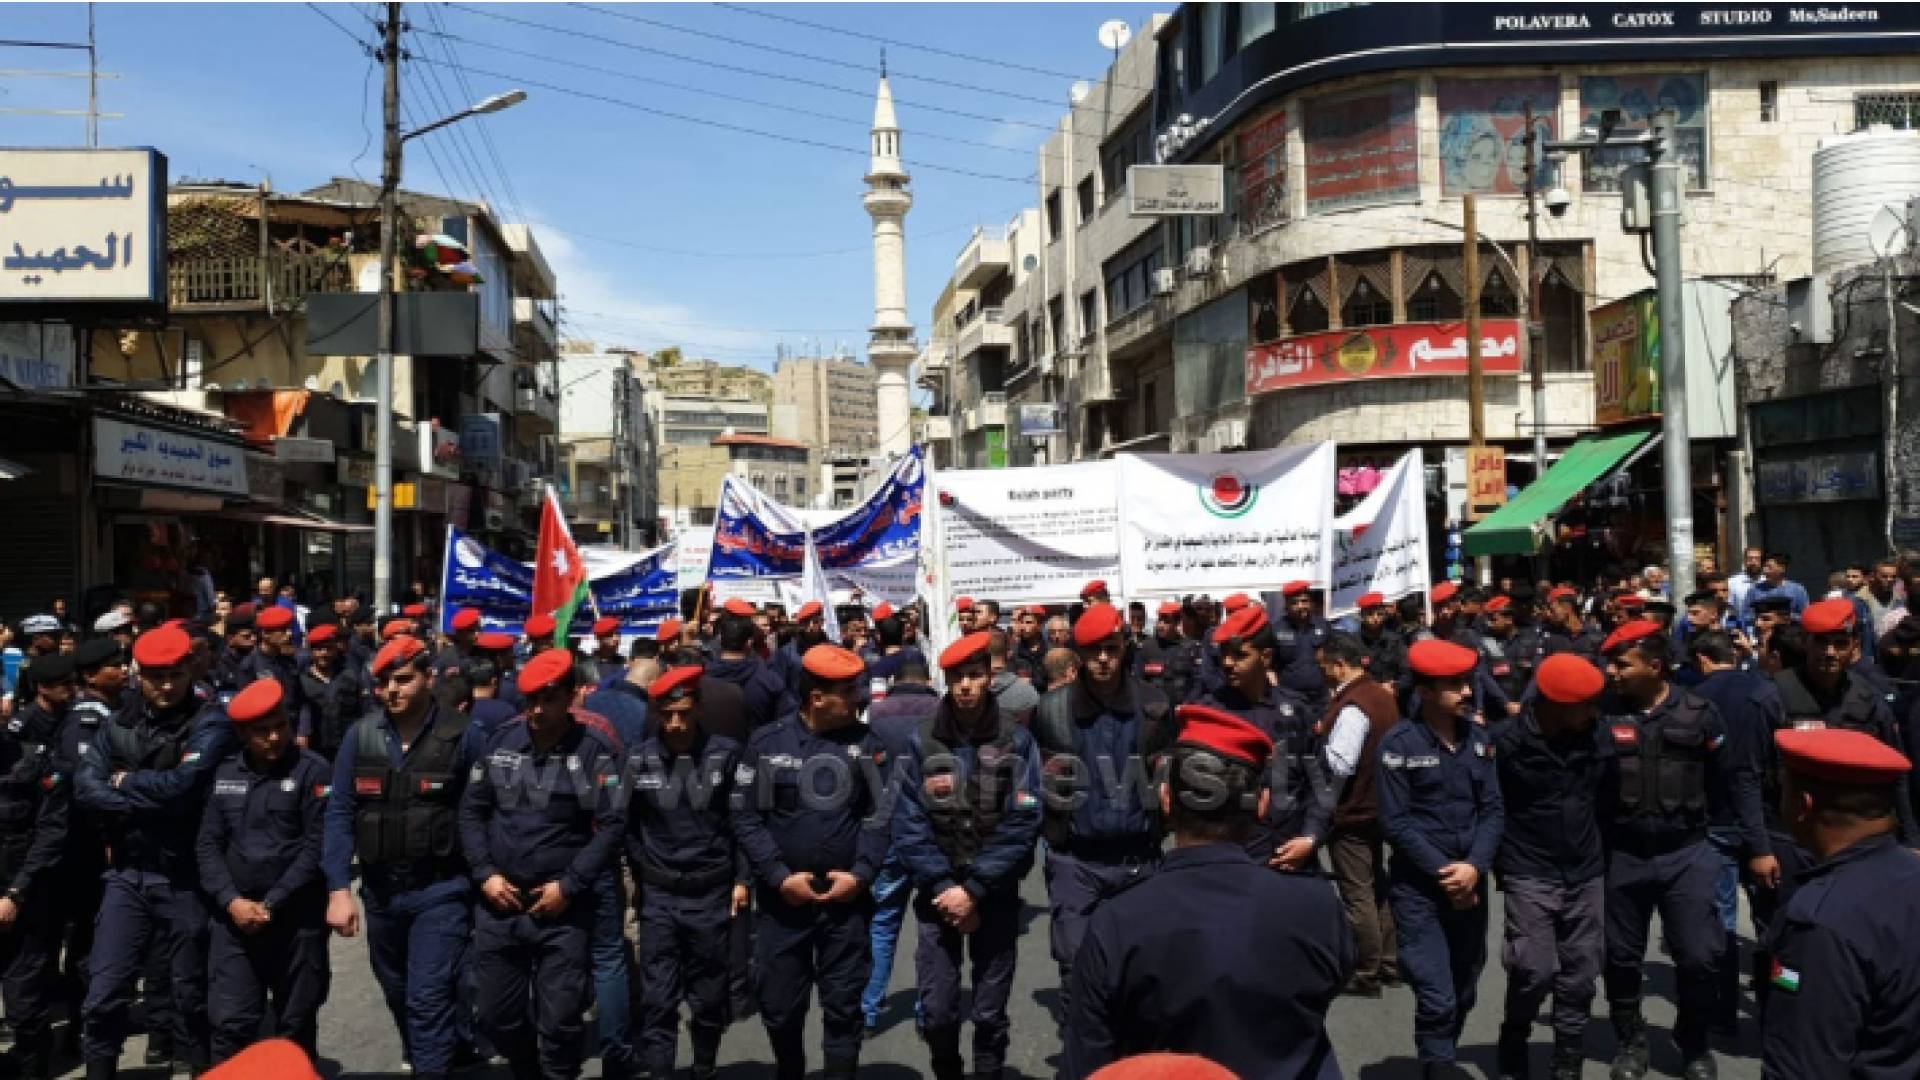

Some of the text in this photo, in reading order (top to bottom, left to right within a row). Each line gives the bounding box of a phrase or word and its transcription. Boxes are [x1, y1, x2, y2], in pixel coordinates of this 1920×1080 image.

[1494, 14, 1591, 30] POLAVERA
[1612, 12, 1674, 27] CATOX
[1699, 9, 1773, 25] STUDIO
[0, 173, 133, 213] سو
[3, 231, 133, 285] الحميد
